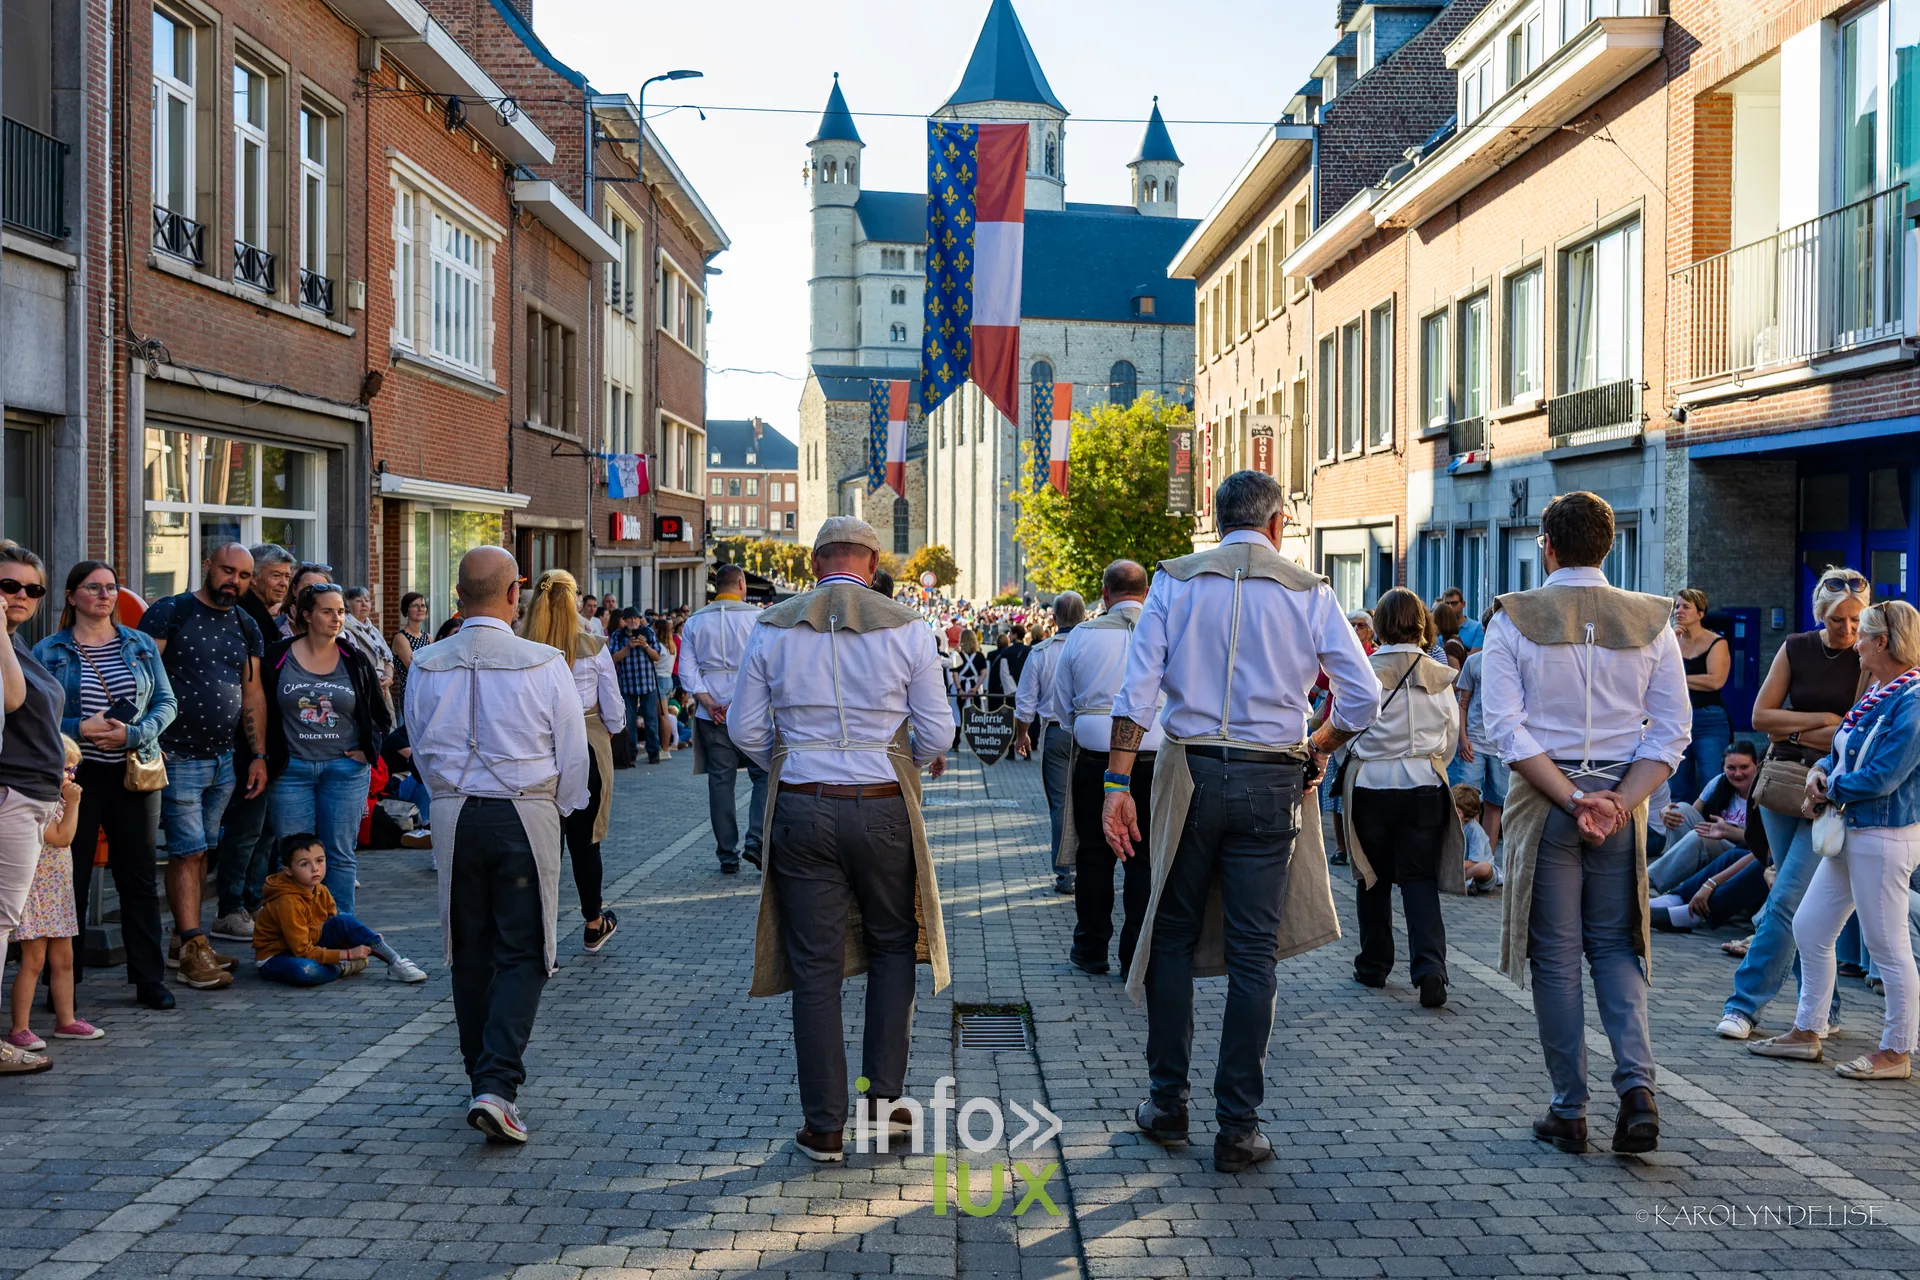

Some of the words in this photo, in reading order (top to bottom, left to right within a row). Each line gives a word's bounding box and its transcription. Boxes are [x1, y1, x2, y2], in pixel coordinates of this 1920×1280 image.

[1259, 437, 1267, 473] HOTE
[283, 682, 311, 695] Ciao
[313, 681, 356, 696] Amore
[965, 724, 980, 734] Jean
[987, 725, 1012, 734] Nivelles
[974, 736, 1002, 746] Nivelles
